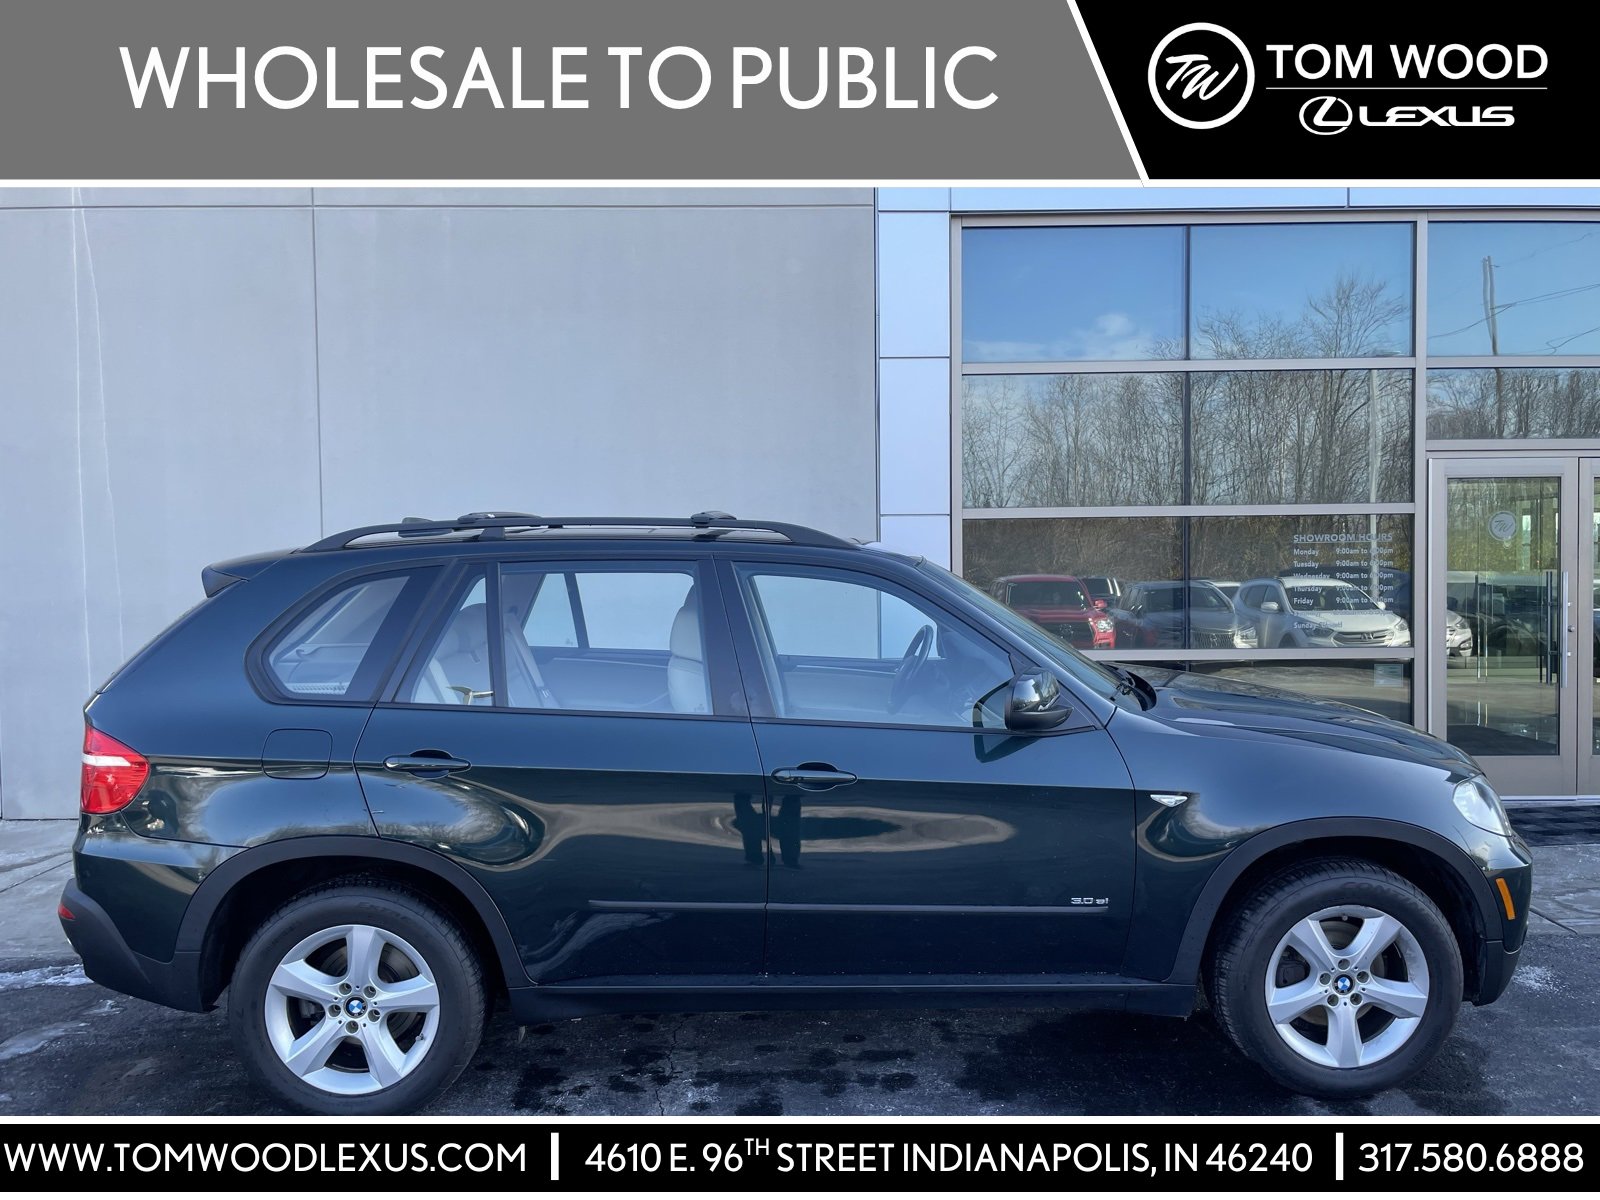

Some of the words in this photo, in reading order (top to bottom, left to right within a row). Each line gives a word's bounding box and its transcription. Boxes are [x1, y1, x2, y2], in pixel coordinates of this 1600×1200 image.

[1293, 533, 1356, 542] SHOWROOM
[1293, 549, 1320, 557] Monday
[1369, 548, 1394, 556] 600pm
[1293, 561, 1320, 569] Tuesday
[1369, 560, 1394, 568] 600pm
[1369, 572, 1394, 580] 600pm
[1293, 585, 1323, 594] Thursday
[1293, 597, 1314, 606] Friday
[1293, 621, 1317, 631] Sunday
